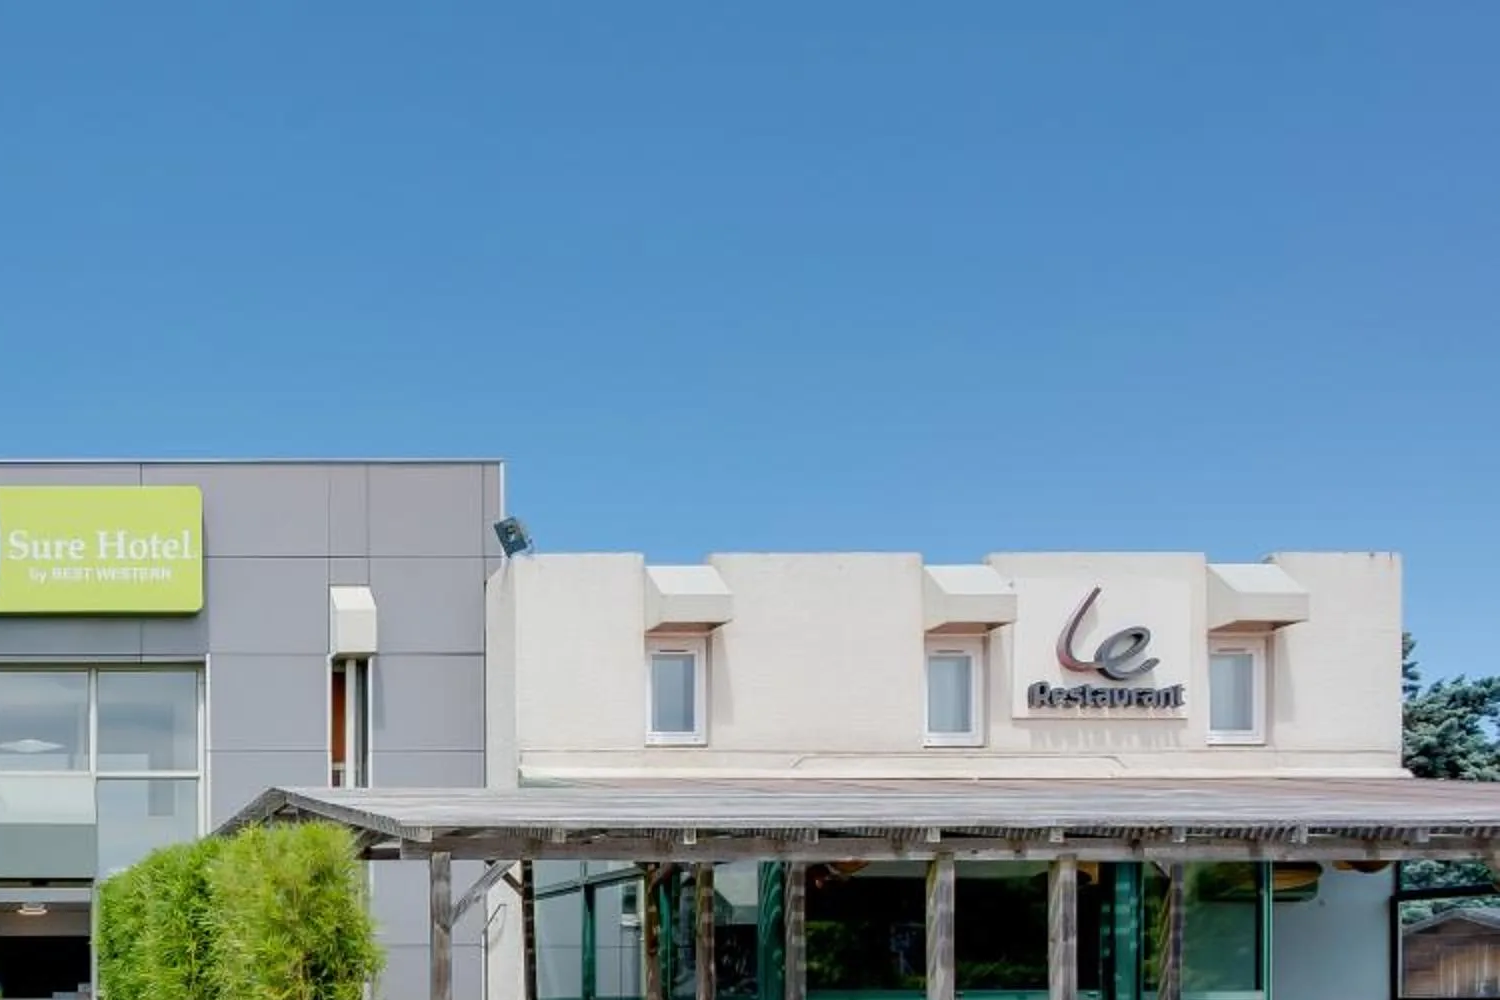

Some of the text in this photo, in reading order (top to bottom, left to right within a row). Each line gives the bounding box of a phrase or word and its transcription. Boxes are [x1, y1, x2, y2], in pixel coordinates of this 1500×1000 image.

[7, 529, 196, 560] Sure Hotel
[30, 567, 172, 583] by BEST WESTERN
[1027, 681, 1186, 709] Restaurant
